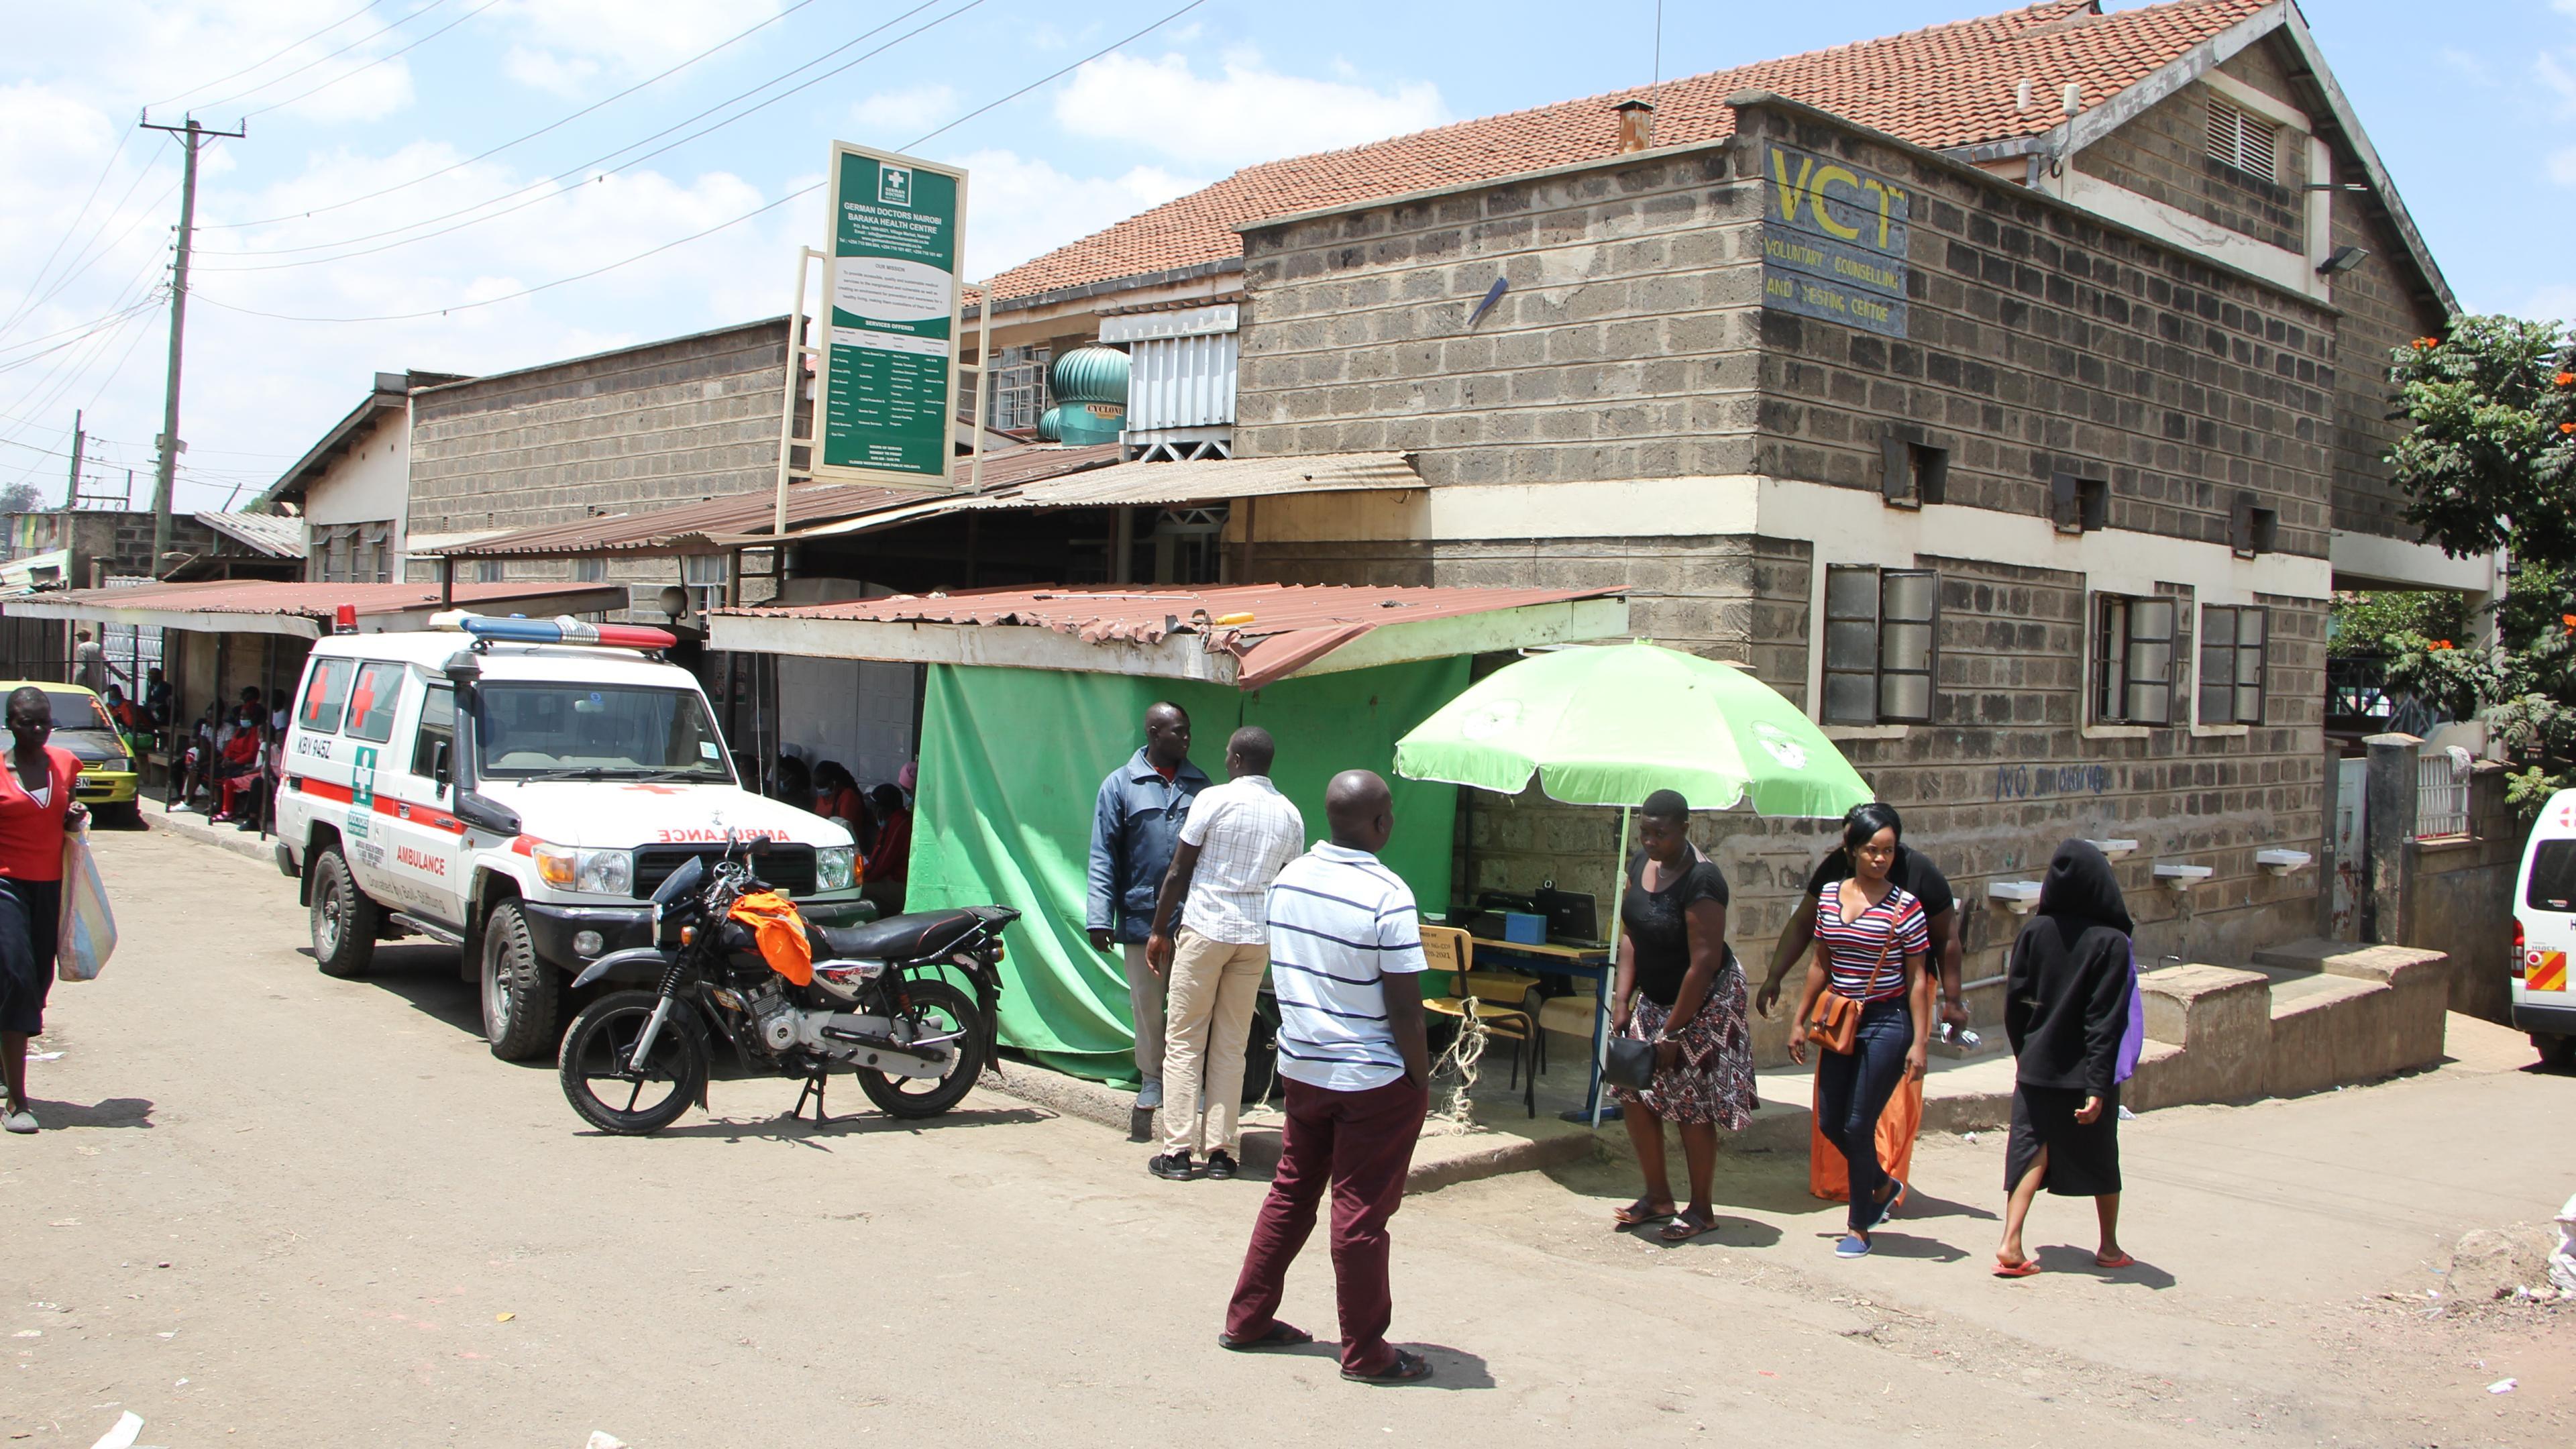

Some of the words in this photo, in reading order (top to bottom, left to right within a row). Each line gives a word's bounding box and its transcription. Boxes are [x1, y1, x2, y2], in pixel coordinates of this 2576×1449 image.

[844, 202, 875, 214] GERMAN
[877, 208, 912, 220] DOCTORS
[913, 214, 942, 225] NAIROBI
[1771, 148, 1905, 249] VCT
[848, 213, 879, 224] BARAKA
[880, 218, 907, 229] HEALTH
[910, 224, 937, 234] CENTRE
[1764, 237, 1824, 267] VOLUNTARY
[1835, 256, 1898, 290] COUNSELLING
[1766, 278, 1793, 297] AND
[1803, 286, 1844, 312] TESTING
[1851, 299, 1888, 322] CENTRE
[298, 735, 312, 754] KBY
[313, 739, 331, 759] 945Z
[1996, 765, 2027, 802] NO
[397, 845, 445, 876] AMBULANCE
